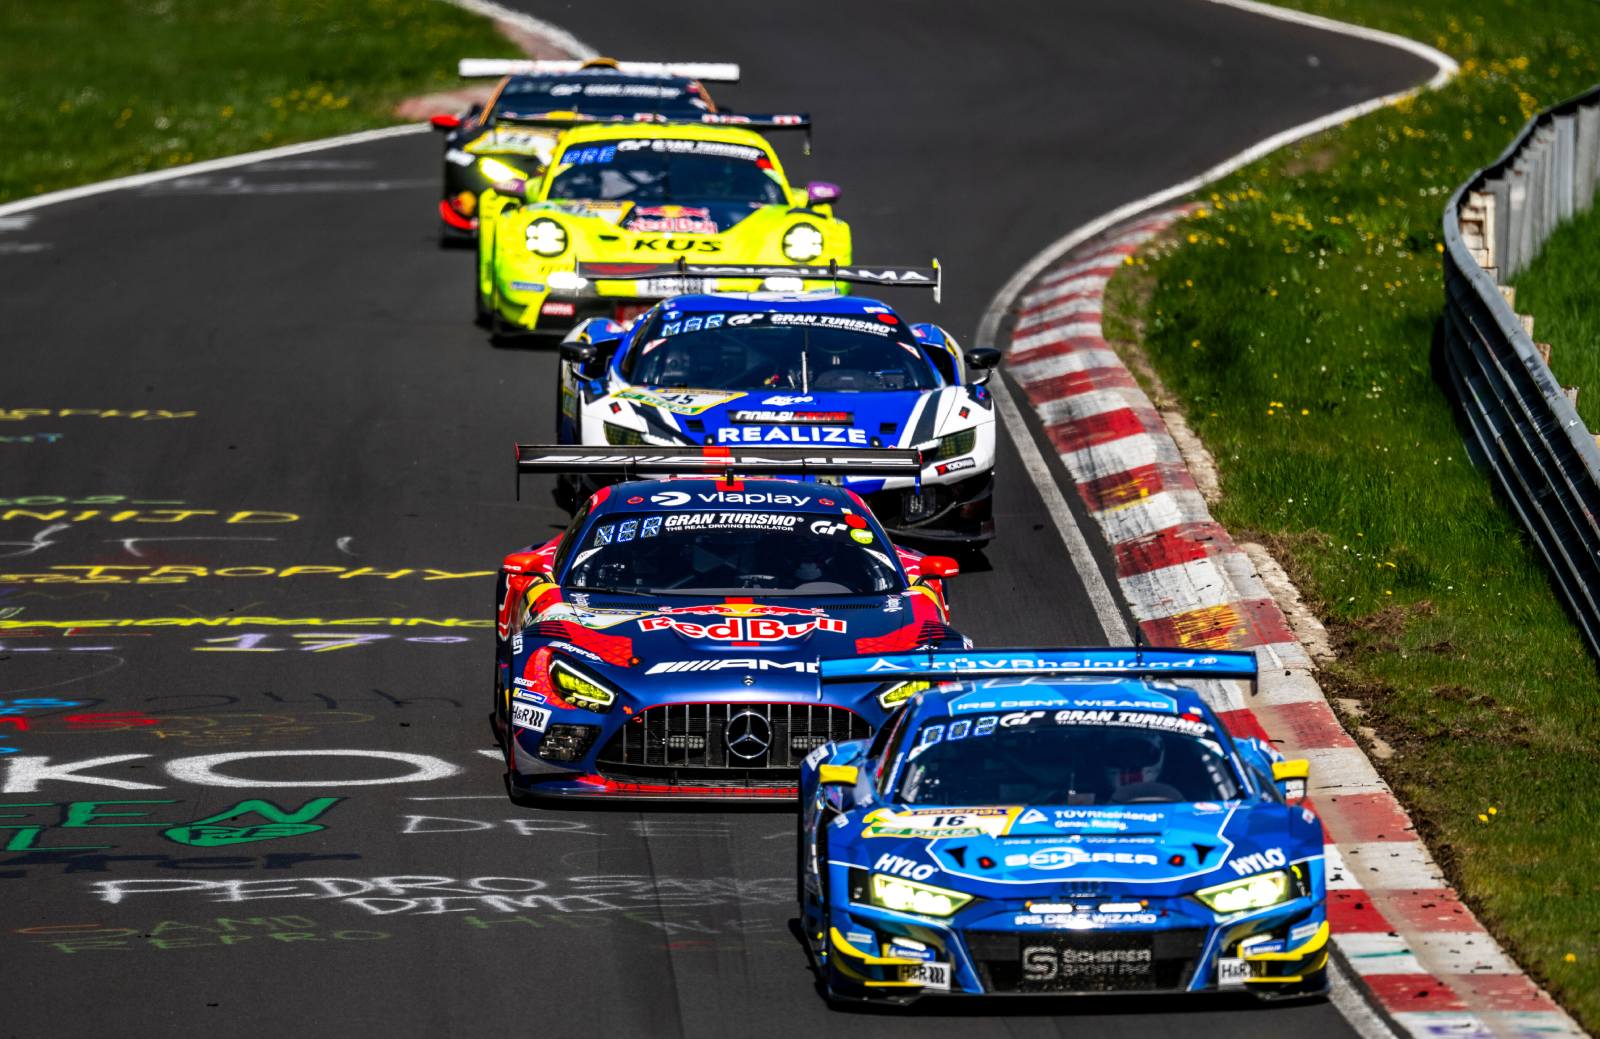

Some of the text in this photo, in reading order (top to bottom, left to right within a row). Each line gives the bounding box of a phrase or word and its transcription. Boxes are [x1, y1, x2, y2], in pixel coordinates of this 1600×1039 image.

[634, 239, 721, 251] KUS
[770, 314, 817, 325] GRAN
[719, 427, 867, 444] REALIZE
[698, 491, 811, 506] viaplay
[665, 514, 717, 527] GRAN
[745, 524, 794, 532] SIMULATOR
[50, 565, 497, 581] TROPHY
[638, 616, 847, 641] Red Bull
[1001, 699, 1068, 708] DENT
[1074, 699, 1169, 709] WIZARD
[1055, 710, 1113, 723] GRAN
[932, 815, 967, 827] 16
[1005, 852, 1157, 866] SCHERER
[1230, 848, 1286, 876] HYLO
[874, 853, 935, 880] HYLO
[90, 876, 547, 903] PEDRO
